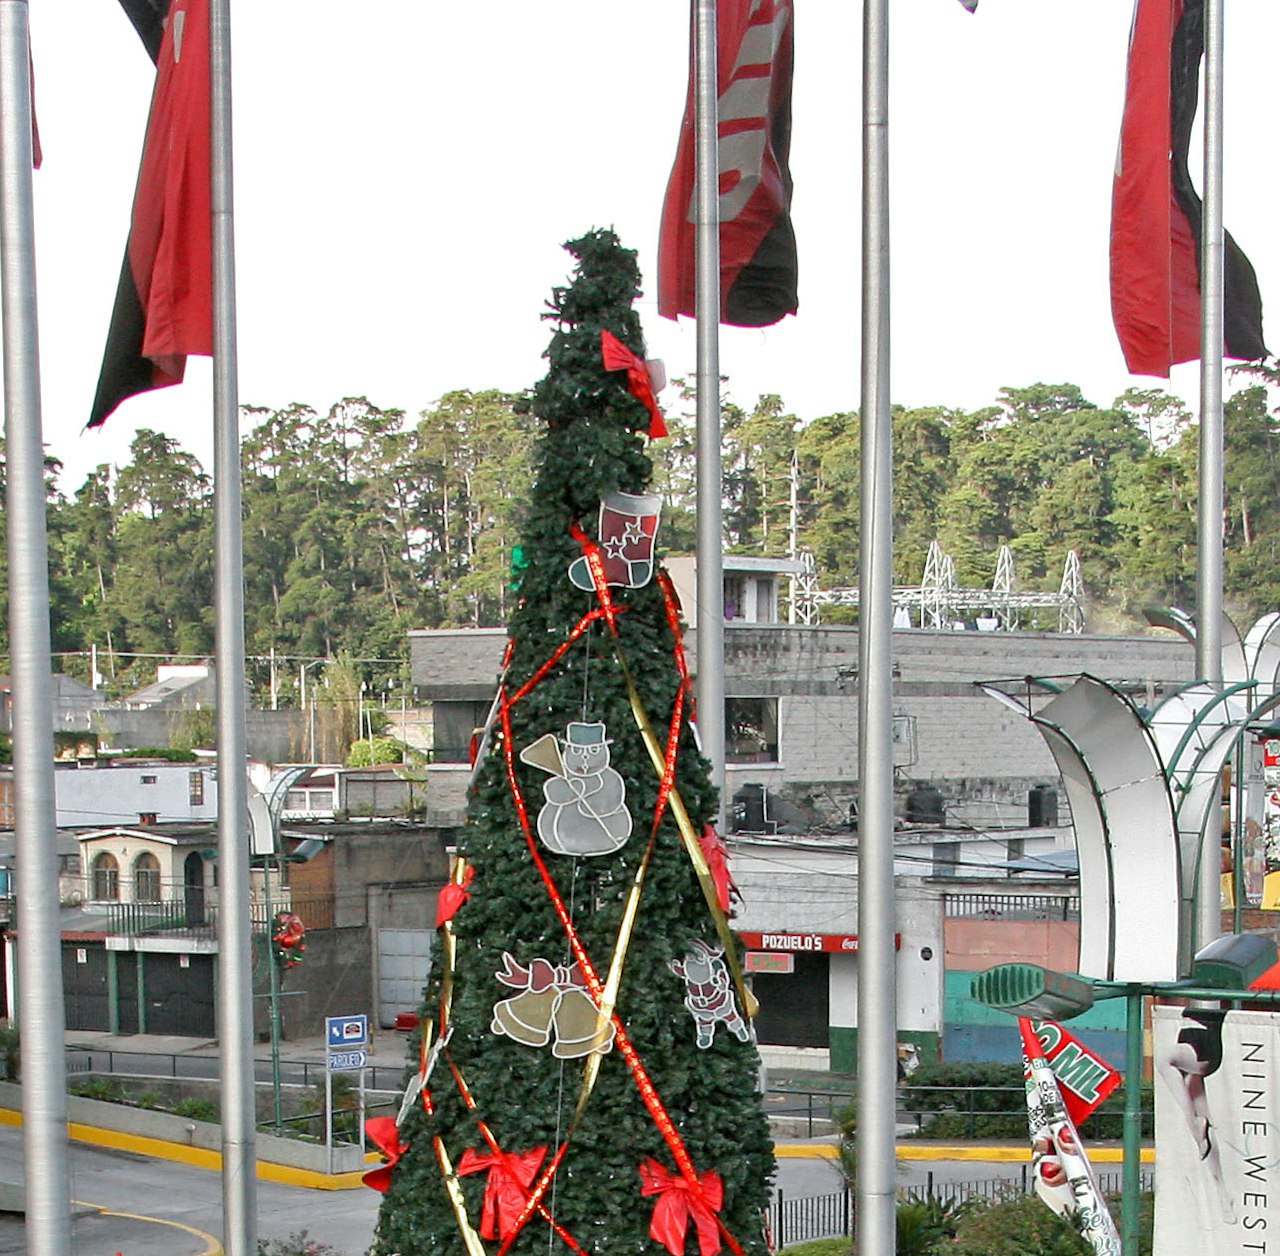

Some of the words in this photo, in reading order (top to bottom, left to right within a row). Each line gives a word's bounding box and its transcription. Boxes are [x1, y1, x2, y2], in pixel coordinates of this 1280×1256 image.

[762, 934, 823, 951] POZUELO'S
[1050, 1041, 1111, 1104] MIL
[1241, 1042, 1267, 1138] NINE
[1242, 1155, 1268, 1254] WEST
